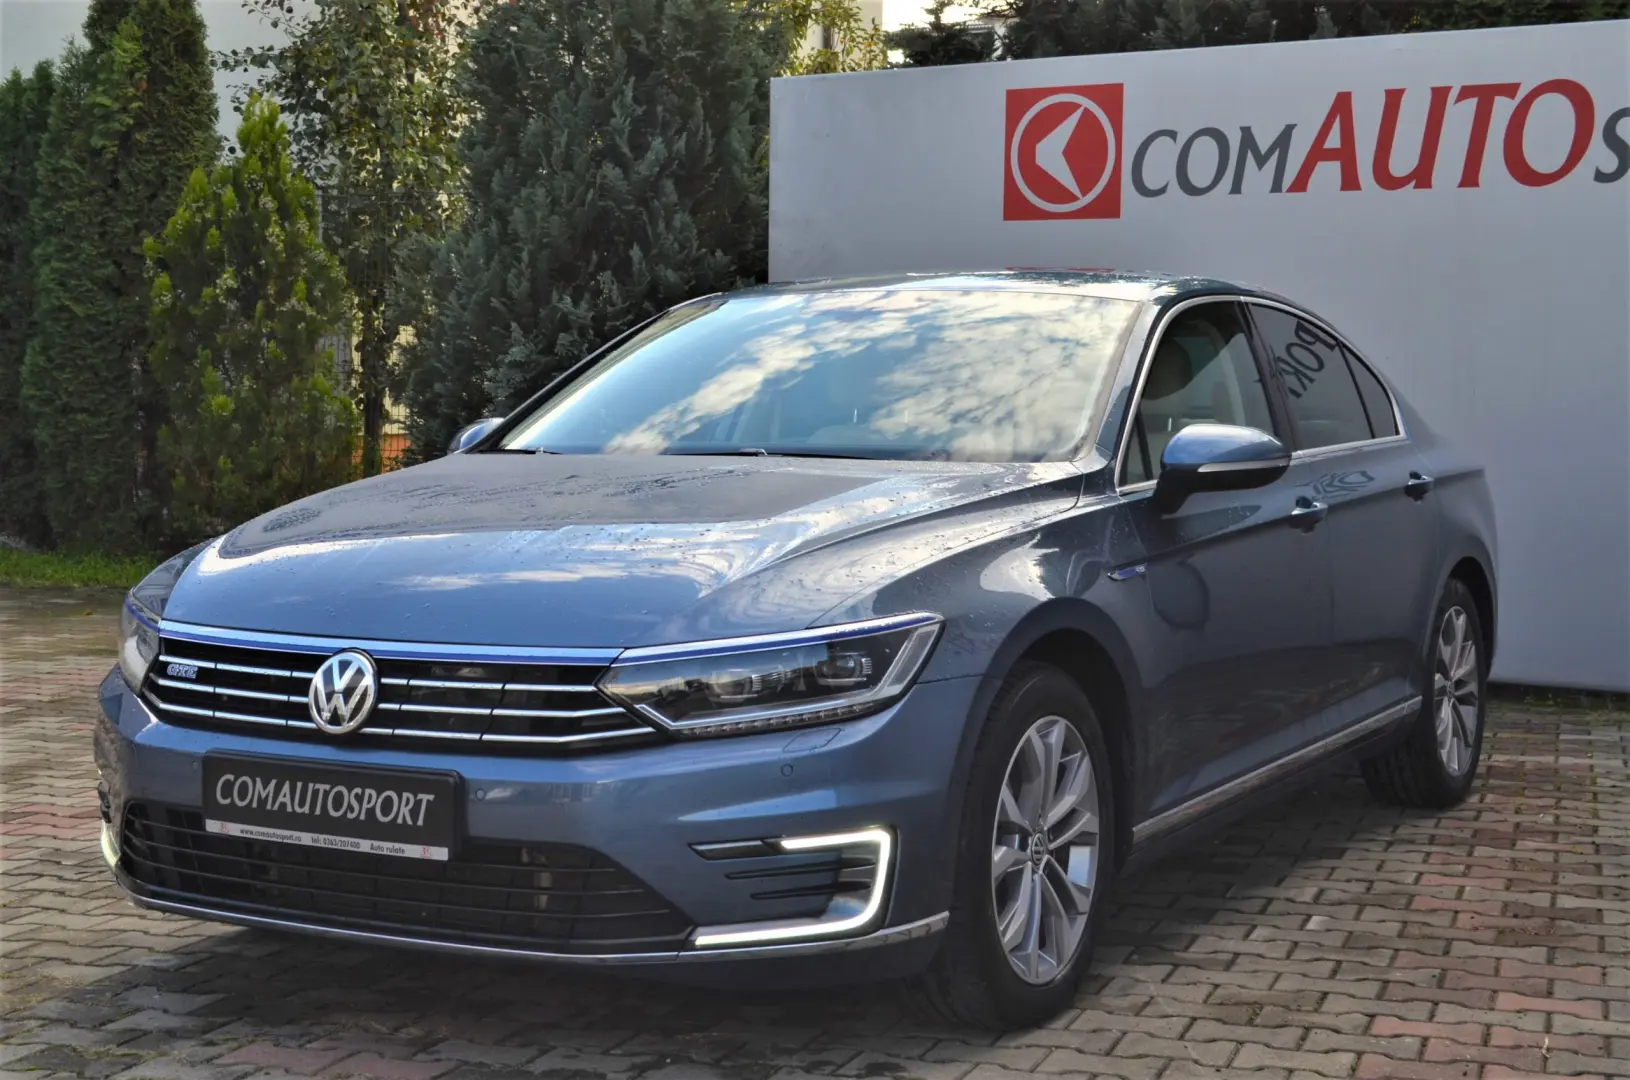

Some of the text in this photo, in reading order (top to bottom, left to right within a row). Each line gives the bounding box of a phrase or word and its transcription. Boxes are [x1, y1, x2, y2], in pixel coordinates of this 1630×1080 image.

[166, 663, 199, 679] GTE
[313, 654, 374, 731] VW
[215, 773, 435, 827] COMAUTOSPORT
[239, 828, 302, 844] www.comautosport.ro
[369, 842, 385, 852] Auto
[386, 845, 406, 855] rulate
